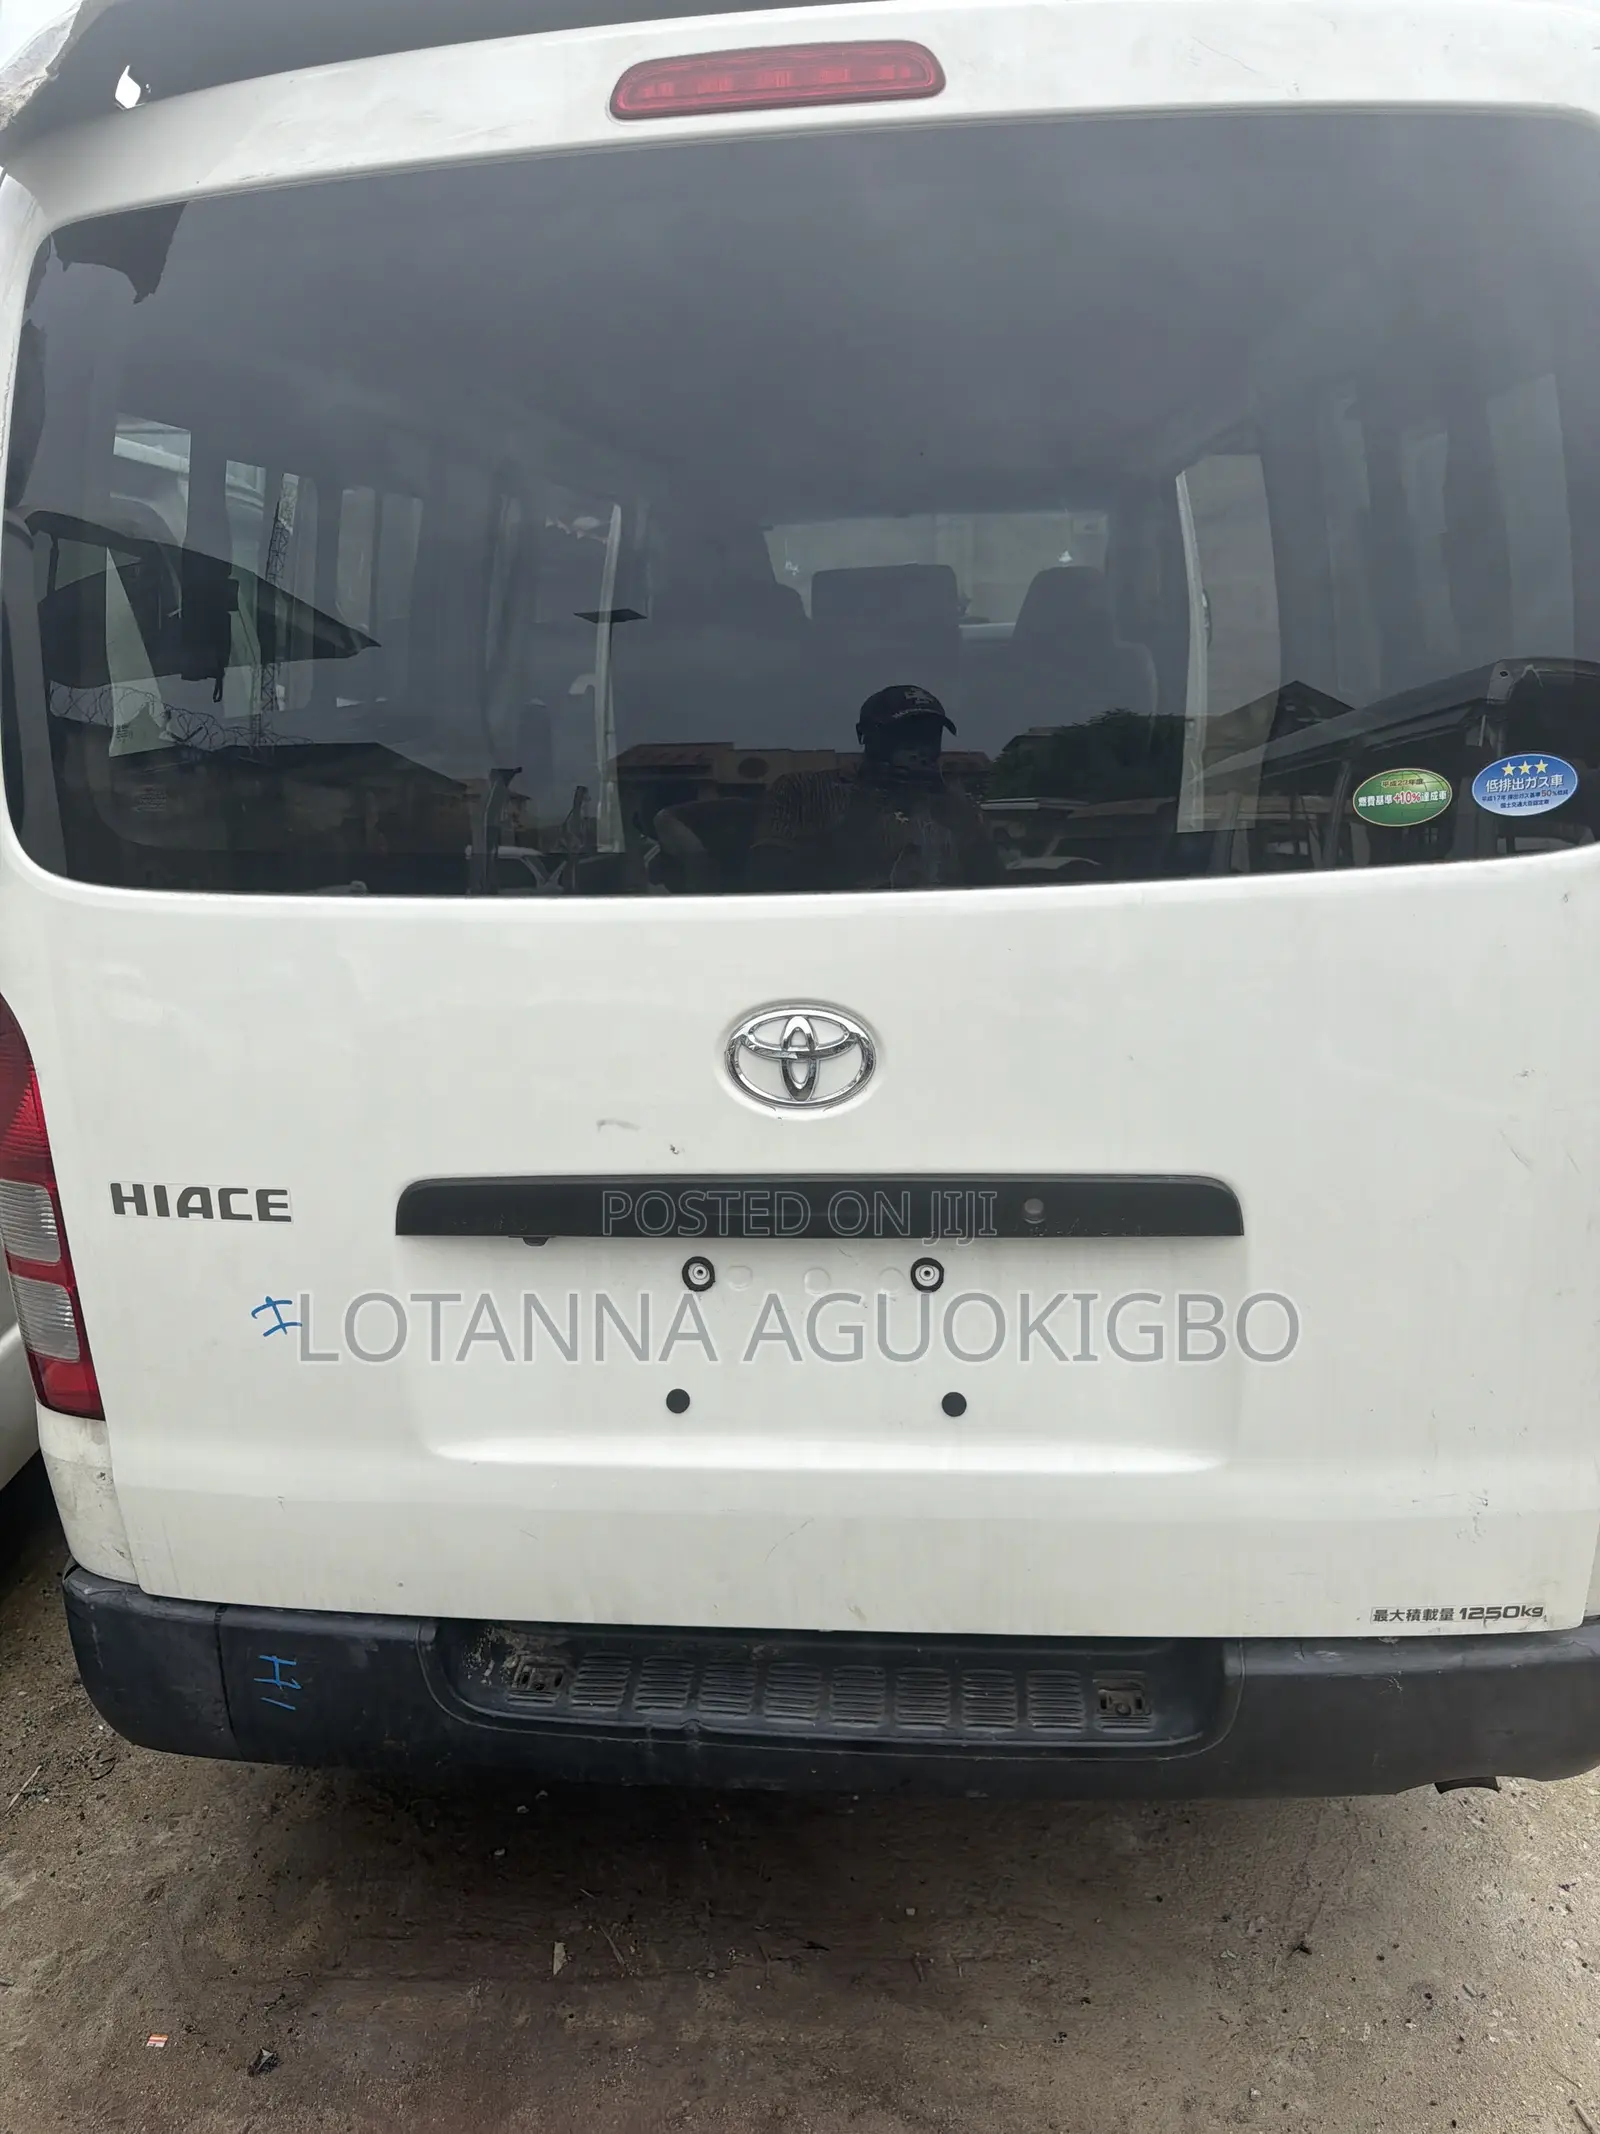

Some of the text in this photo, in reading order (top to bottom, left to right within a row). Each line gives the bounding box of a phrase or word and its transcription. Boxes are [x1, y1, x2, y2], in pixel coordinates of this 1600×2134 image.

[1486, 774, 1564, 793] 低排出ガス車
[1358, 790, 1448, 807] 燃費基準+10%達成車
[110, 1183, 291, 1222] HIACE
[1373, 1605, 1544, 1622] 最大積載量 1250kg
